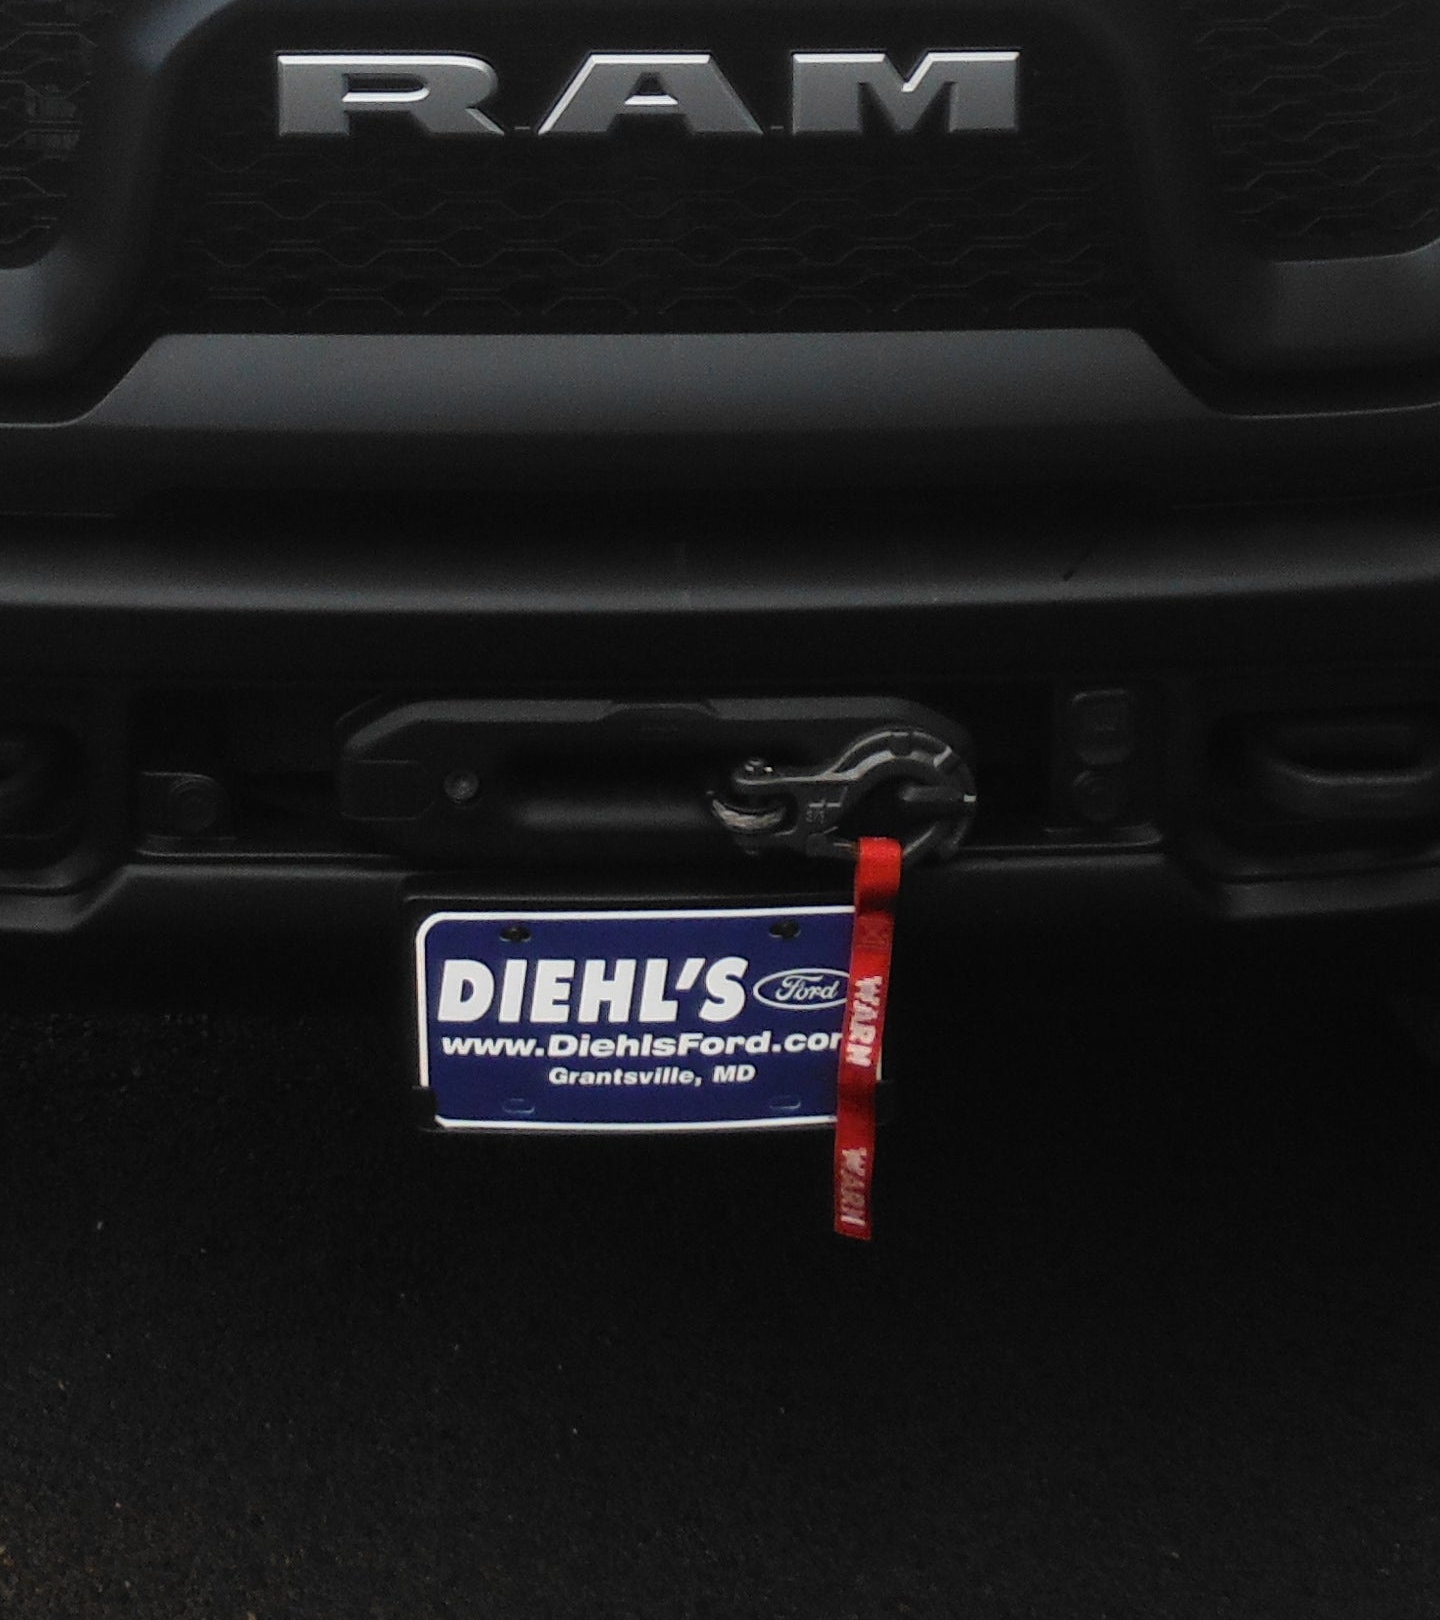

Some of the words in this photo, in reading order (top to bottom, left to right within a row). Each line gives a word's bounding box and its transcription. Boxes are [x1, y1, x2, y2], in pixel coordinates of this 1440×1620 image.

[277, 50, 1021, 136] RAM
[437, 956, 749, 1023] DIEHL'S
[775, 974, 840, 1001] Ford
[845, 975, 883, 1067] WARN
[547, 1066, 702, 1087] Grantsville,
[712, 1064, 757, 1084] MD
[840, 1146, 867, 1227] WARN
